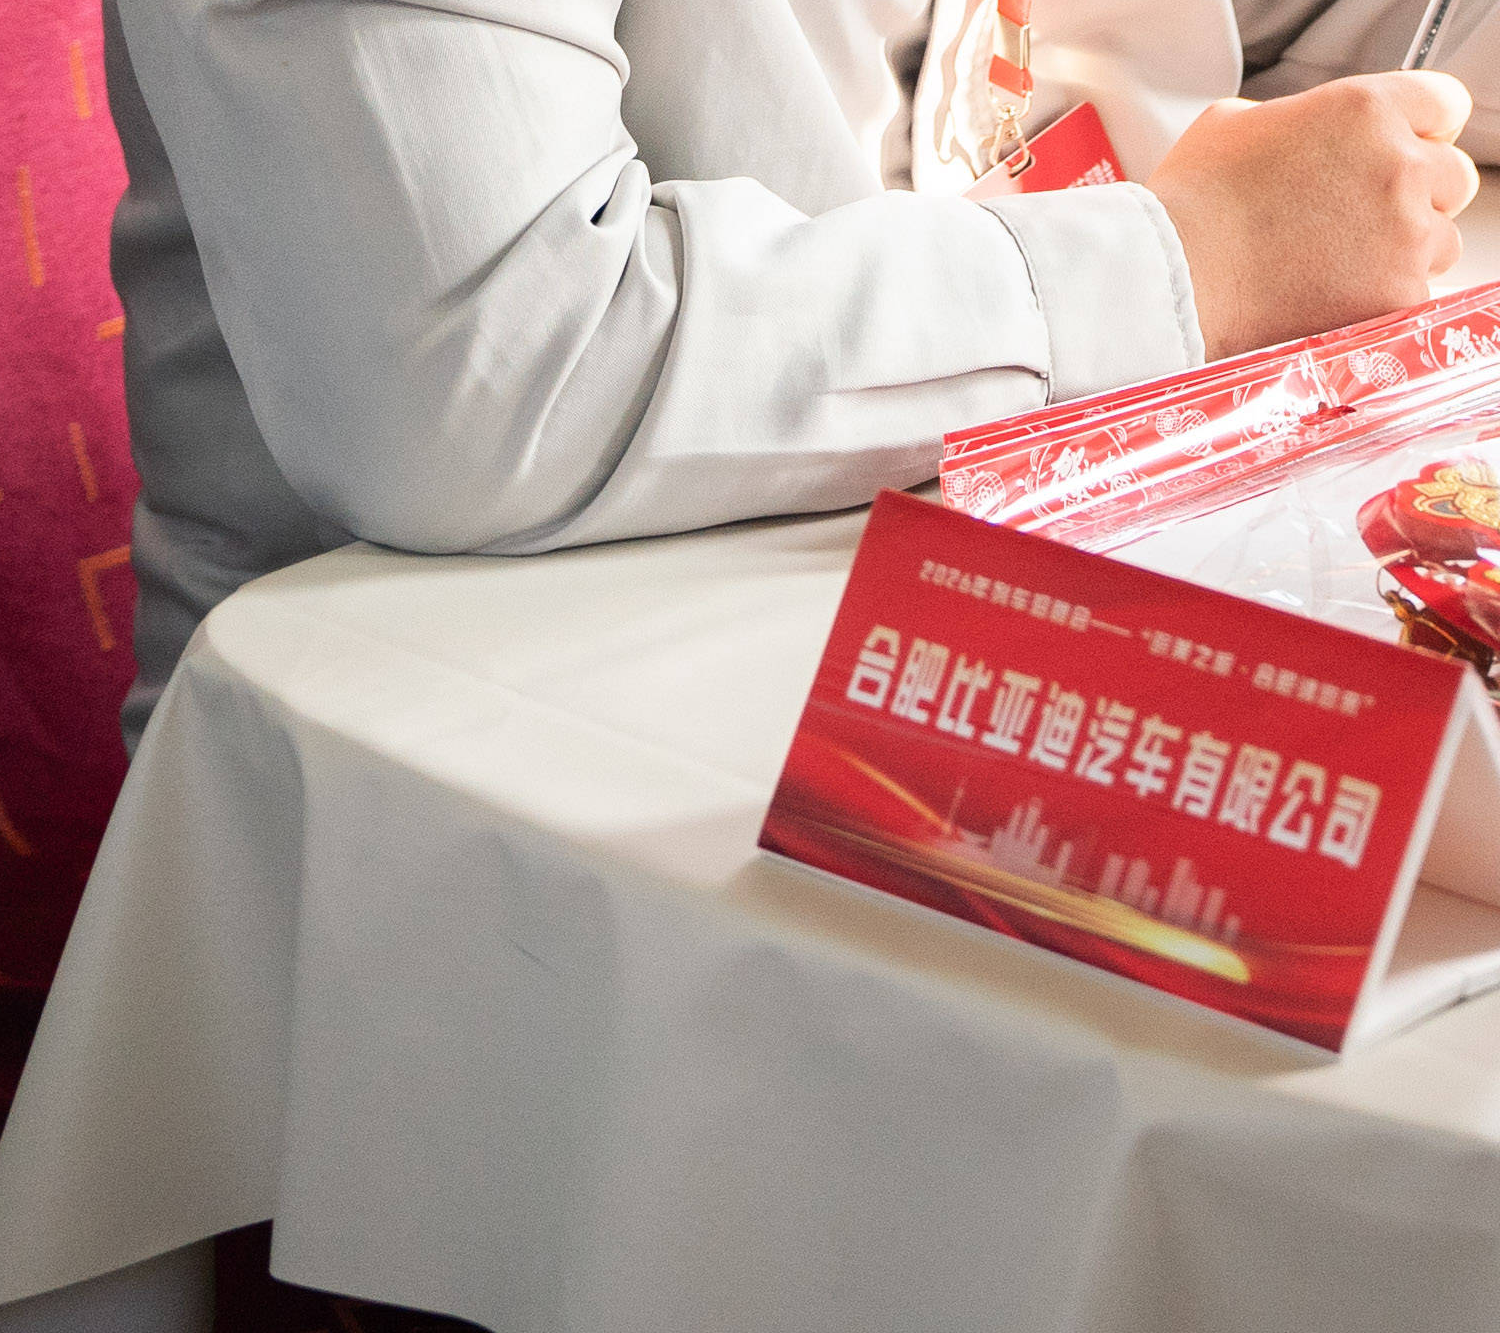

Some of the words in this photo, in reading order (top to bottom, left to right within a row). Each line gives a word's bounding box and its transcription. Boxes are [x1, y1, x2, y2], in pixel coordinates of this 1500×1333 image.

[846, 624, 1383, 870] 合肥比亚迪汽车有限公司
